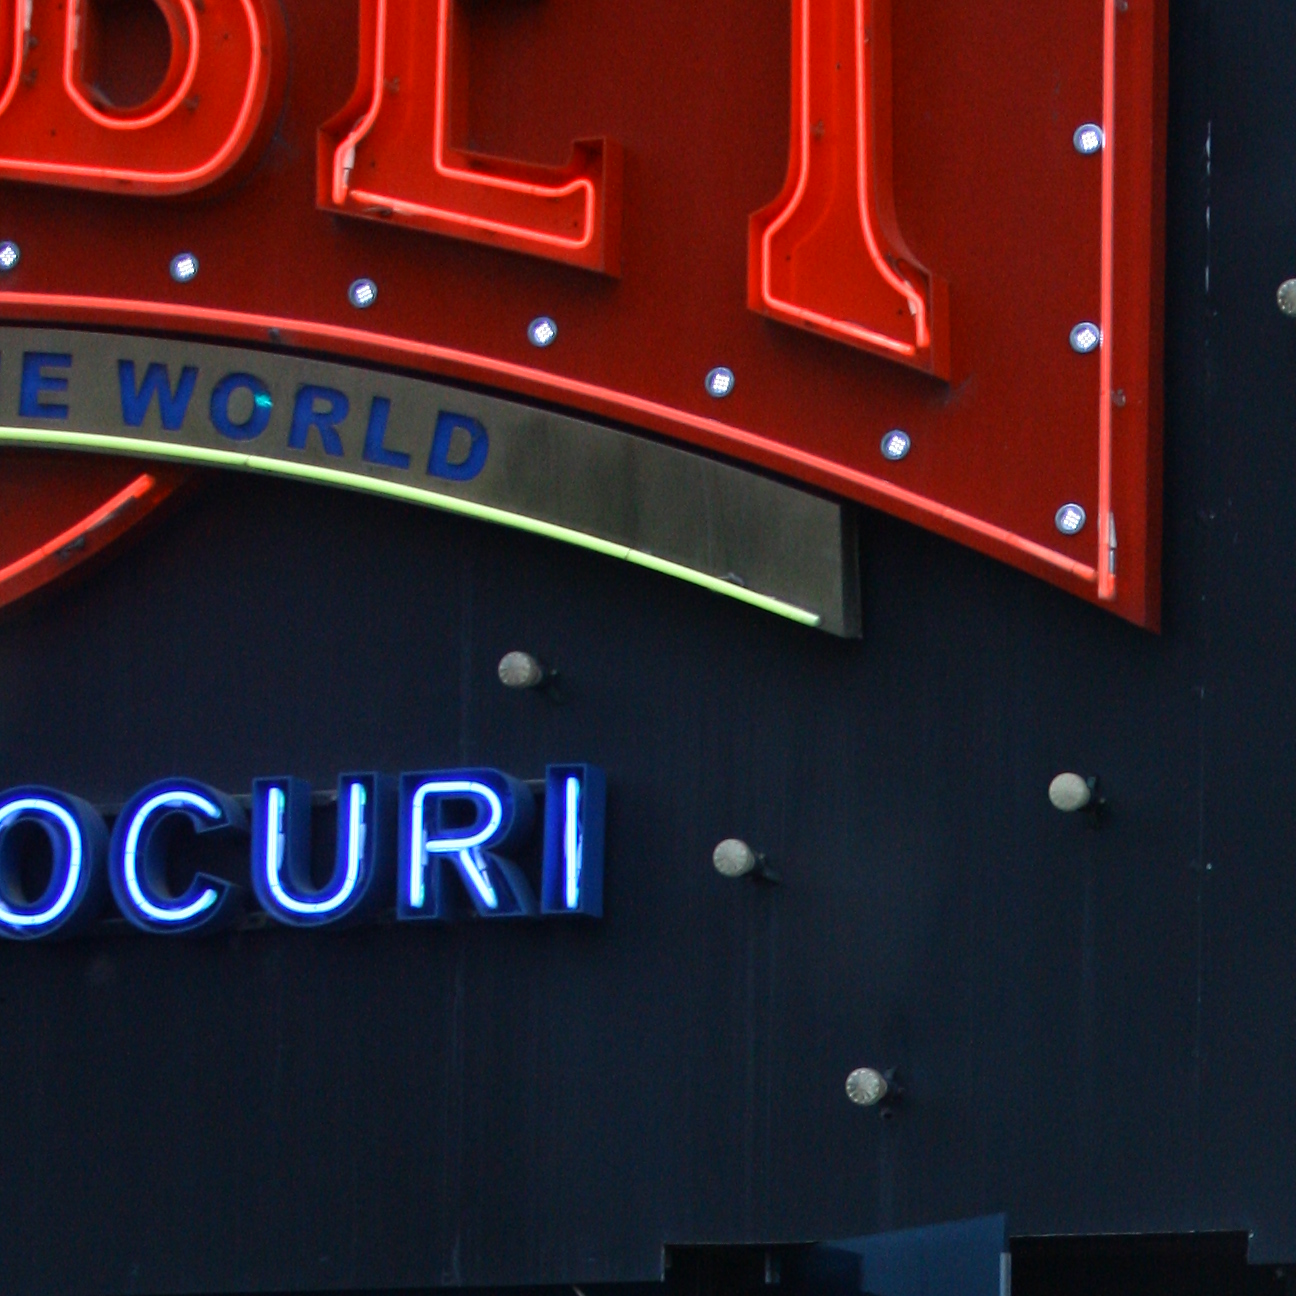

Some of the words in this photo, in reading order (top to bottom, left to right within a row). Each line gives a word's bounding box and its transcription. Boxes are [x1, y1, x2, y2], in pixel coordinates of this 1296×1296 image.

[0, 350, 73, 420] E
[117, 357, 491, 483] WORLD
[0, 763, 602, 940] OCURI
